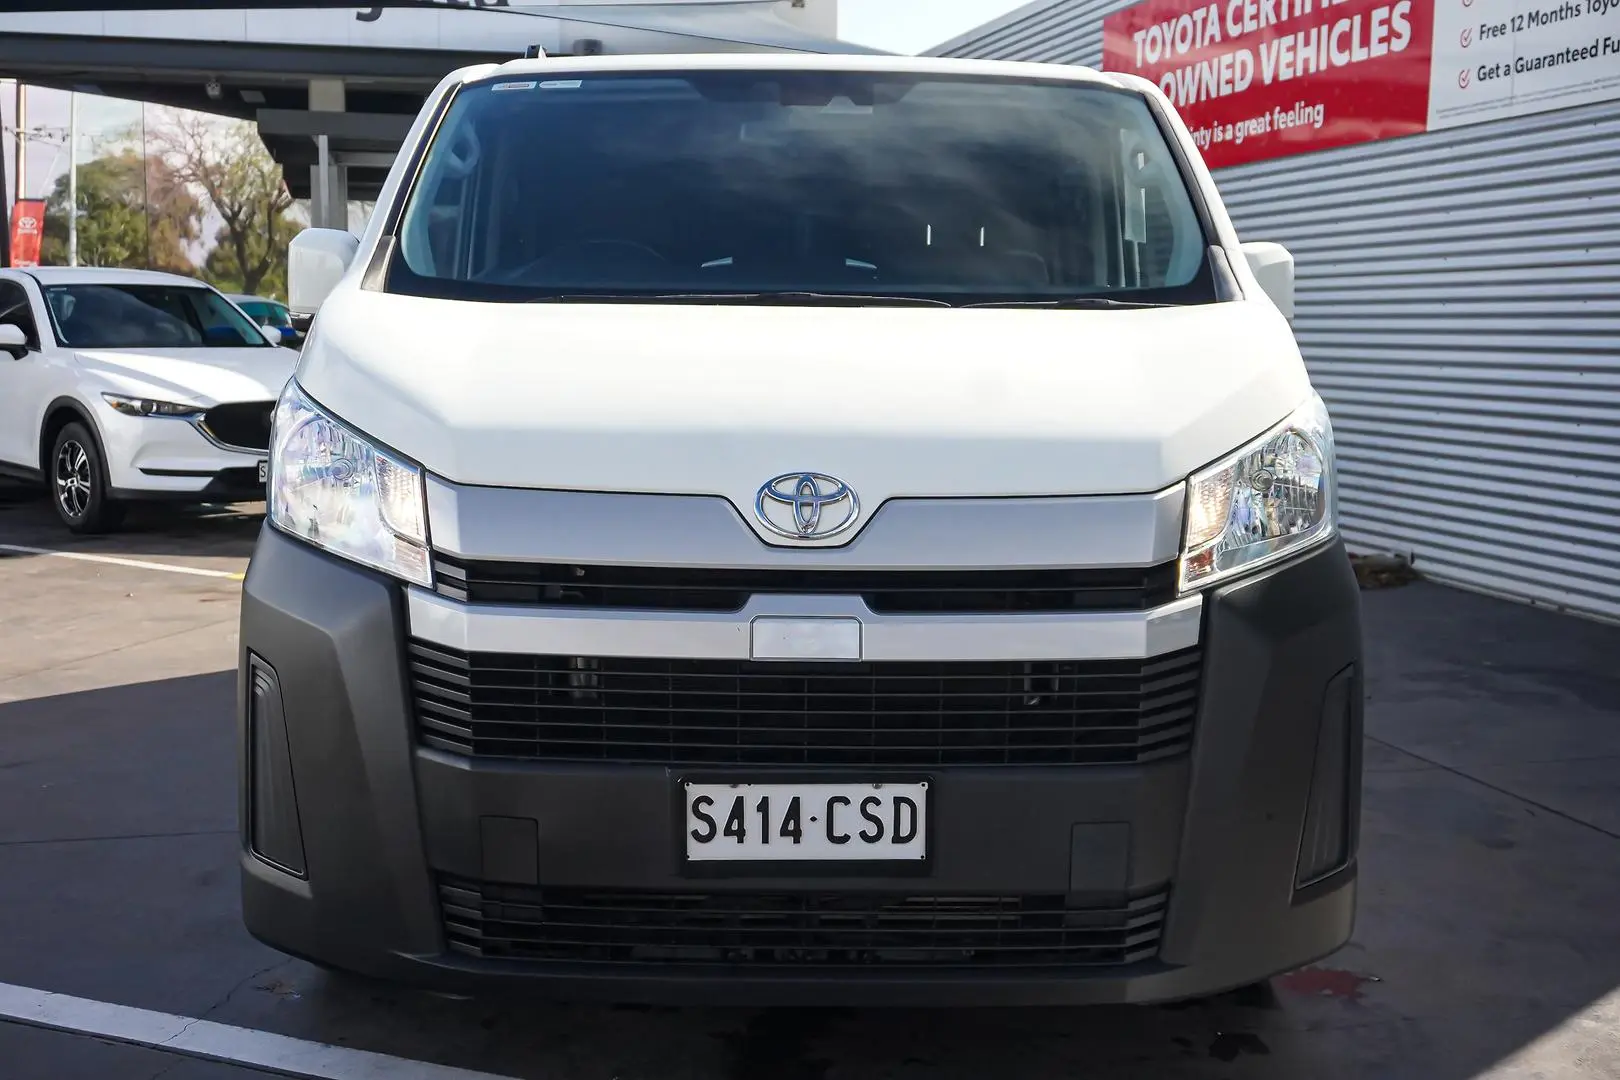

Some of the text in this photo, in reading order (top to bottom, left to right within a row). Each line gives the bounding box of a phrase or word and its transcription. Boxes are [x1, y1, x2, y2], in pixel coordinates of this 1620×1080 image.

[1133, 3, 1221, 68] TOYOTA
[1479, 23, 1507, 40] Free
[1510, 15, 1524, 32] 12
[1527, 1, 1581, 28] Months
[1160, 49, 1254, 107] OWNED
[1259, 1, 1411, 85] VEHICLES
[1477, 62, 1500, 81] Get
[1503, 64, 1511, 76] a
[1515, 38, 1599, 73] Guaranteed
[1213, 120, 1223, 142] is
[1225, 124, 1233, 140] a
[1235, 111, 1271, 145] great
[1273, 101, 1324, 129] feeling
